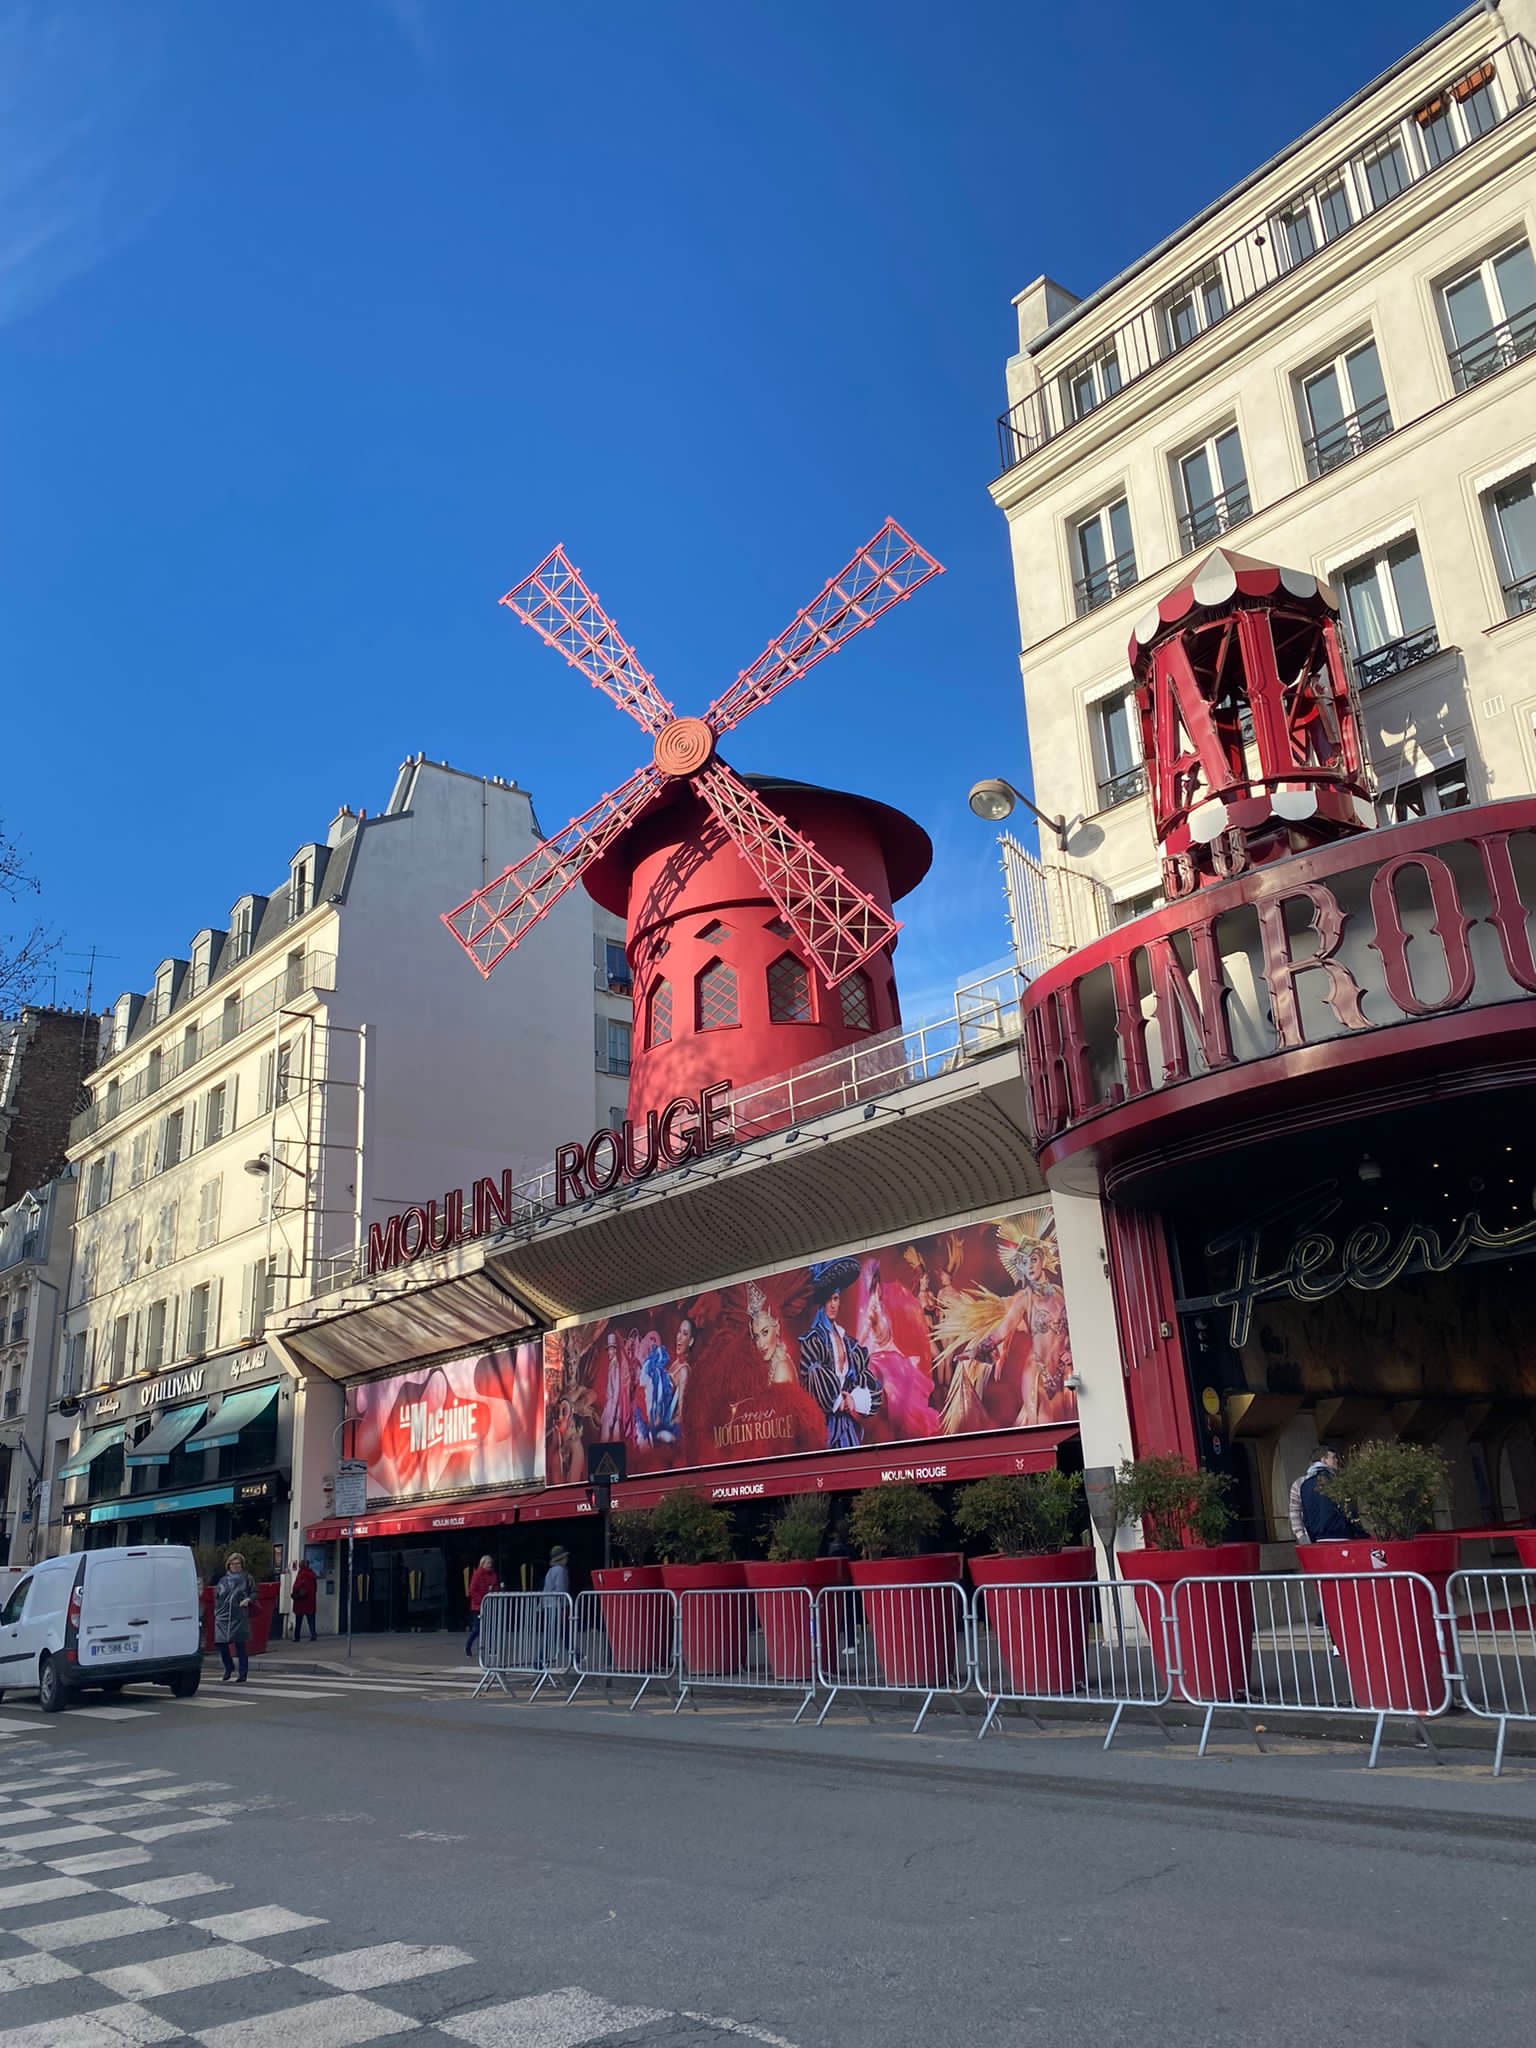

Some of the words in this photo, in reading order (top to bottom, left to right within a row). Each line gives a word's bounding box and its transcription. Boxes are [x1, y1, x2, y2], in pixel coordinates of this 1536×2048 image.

[1161, 828, 1247, 901] DU
[368, 1168, 512, 1276] MOULIN
[555, 1079, 736, 1206] ROUGE
[141, 1369, 205, 1406] O'SULLIVANS
[399, 1404, 410, 1422] LA
[725, 1396, 777, 1427] Forever
[713, 1422, 753, 1449] MOULIN
[754, 1414, 794, 1441] ROUGE
[712, 1487, 738, 1498] MOULIN
[739, 1483, 765, 1496] ROUGE
[881, 1469, 914, 1482] MOULIN
[916, 1466, 947, 1479] ROUGE
